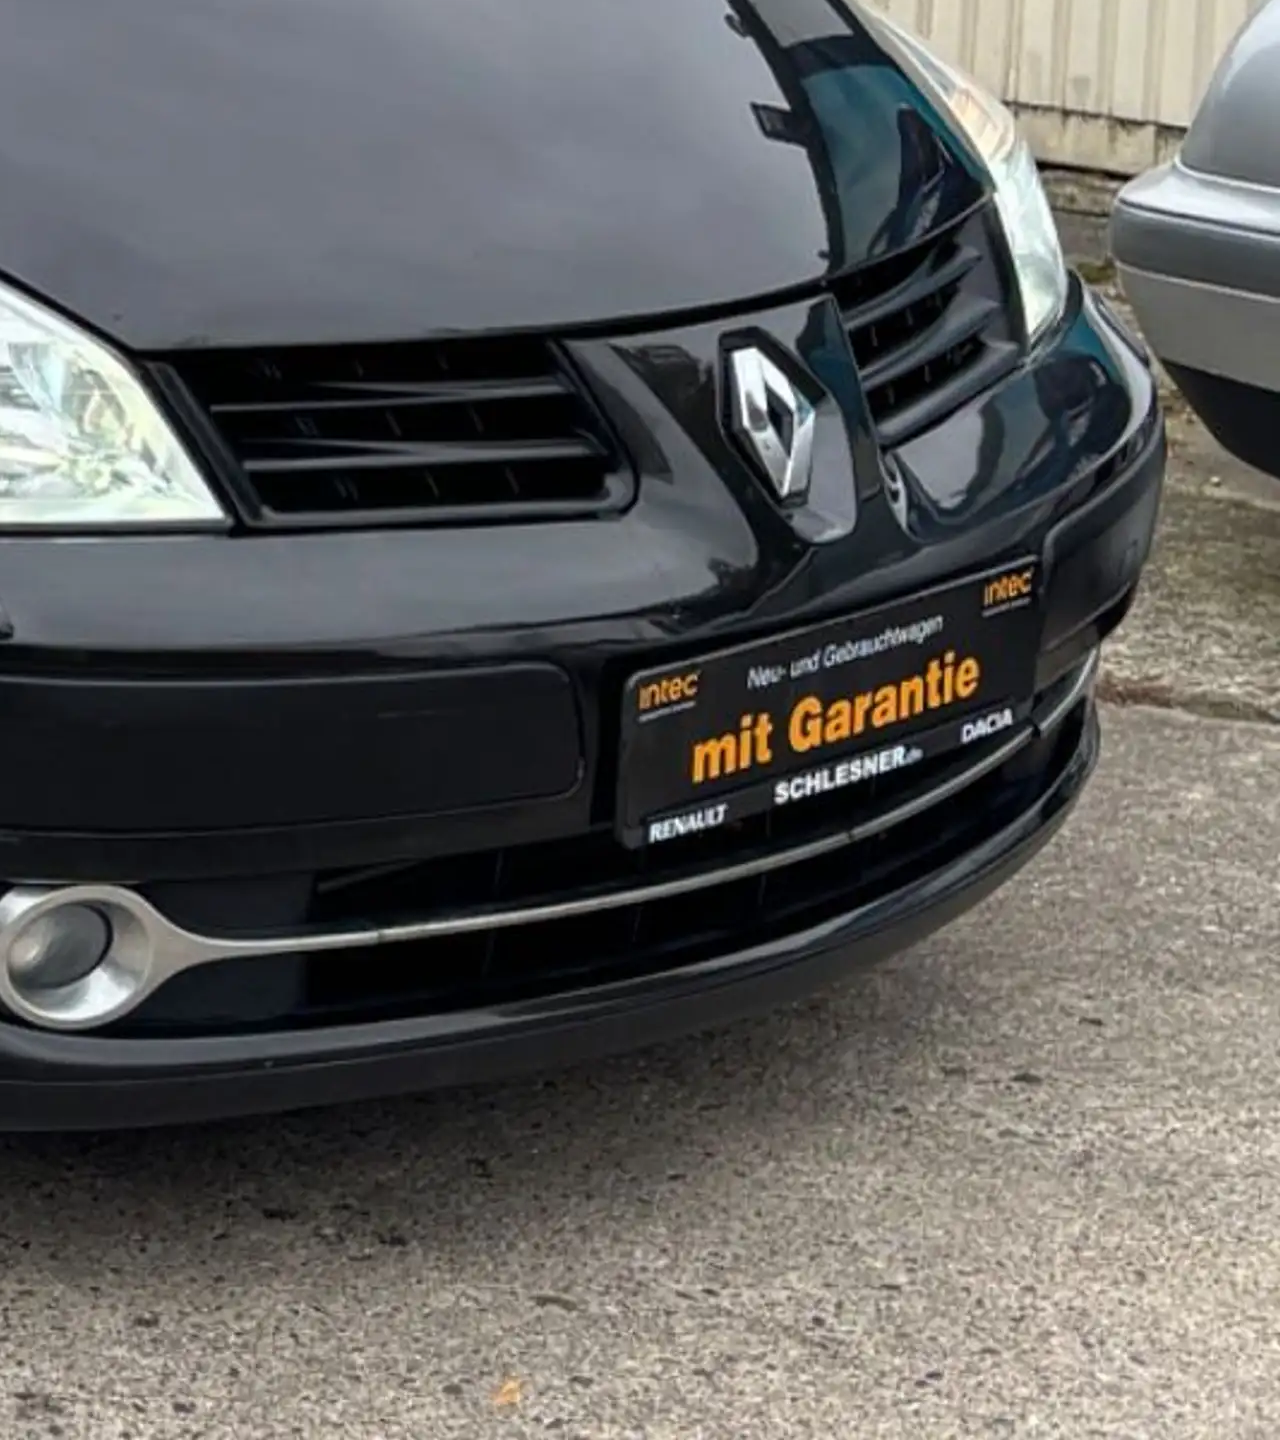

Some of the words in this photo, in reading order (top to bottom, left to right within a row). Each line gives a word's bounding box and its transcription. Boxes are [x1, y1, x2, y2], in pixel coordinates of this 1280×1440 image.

[747, 665, 787, 689] Neu-
[790, 648, 822, 678] und
[823, 615, 944, 668] Gebrauchtwagen
[692, 712, 774, 783] mit
[787, 651, 981, 753] Garantie
[960, 708, 1014, 744] DACIA
[648, 803, 729, 845] RENAULT
